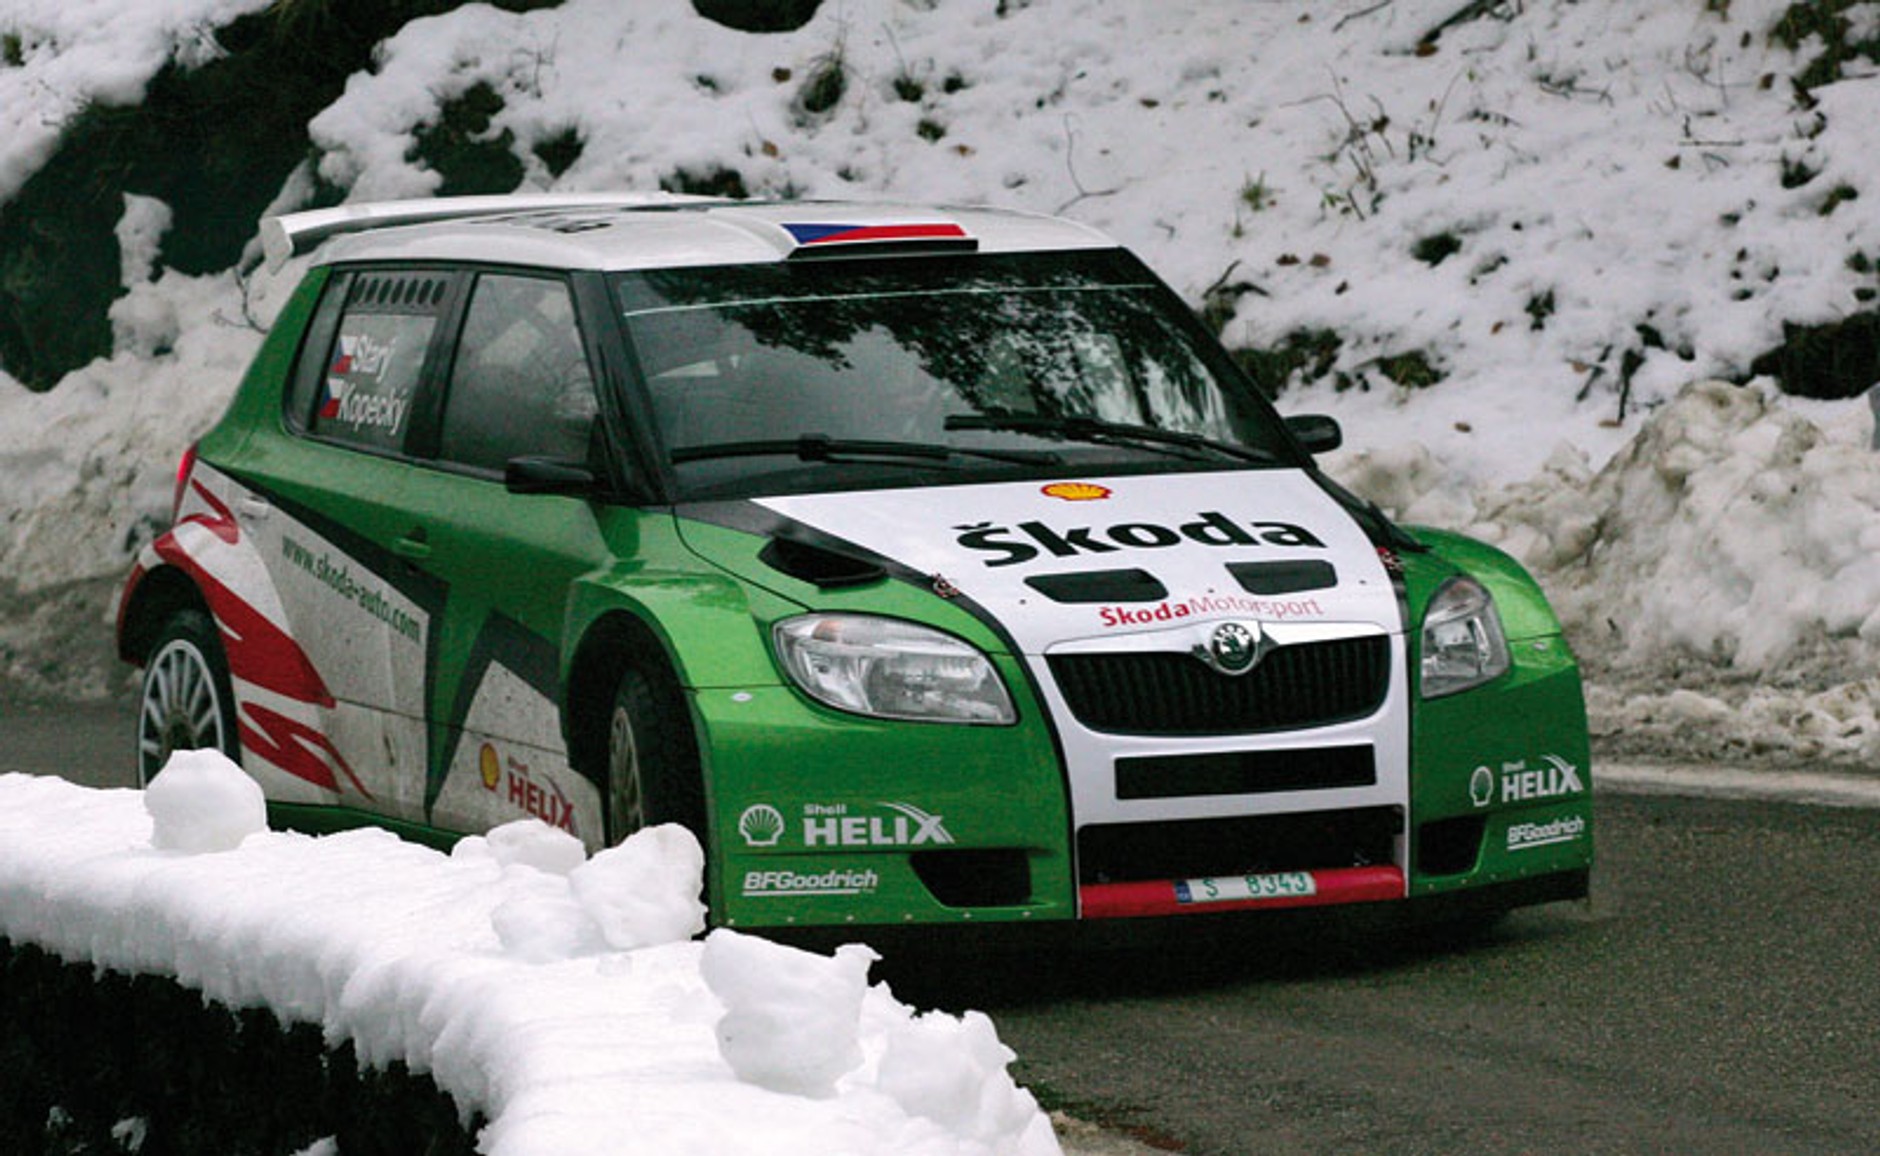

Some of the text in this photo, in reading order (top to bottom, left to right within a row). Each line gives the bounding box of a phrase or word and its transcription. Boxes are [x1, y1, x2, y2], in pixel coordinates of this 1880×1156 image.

[336, 383, 408, 435] Kopecký
[952, 511, 1328, 567] Škoda
[282, 534, 420, 645] www.skoda-auto.com
[1502, 765, 1583, 803] HELIX
[508, 771, 580, 838] HELIX
[803, 803, 847, 816] Shell
[804, 814, 955, 846] HELIX
[1507, 815, 1584, 845] BFGoodrich
[743, 868, 878, 890] BFGoodrich
[1202, 875, 1219, 897] S
[1246, 871, 1307, 894] 8343
